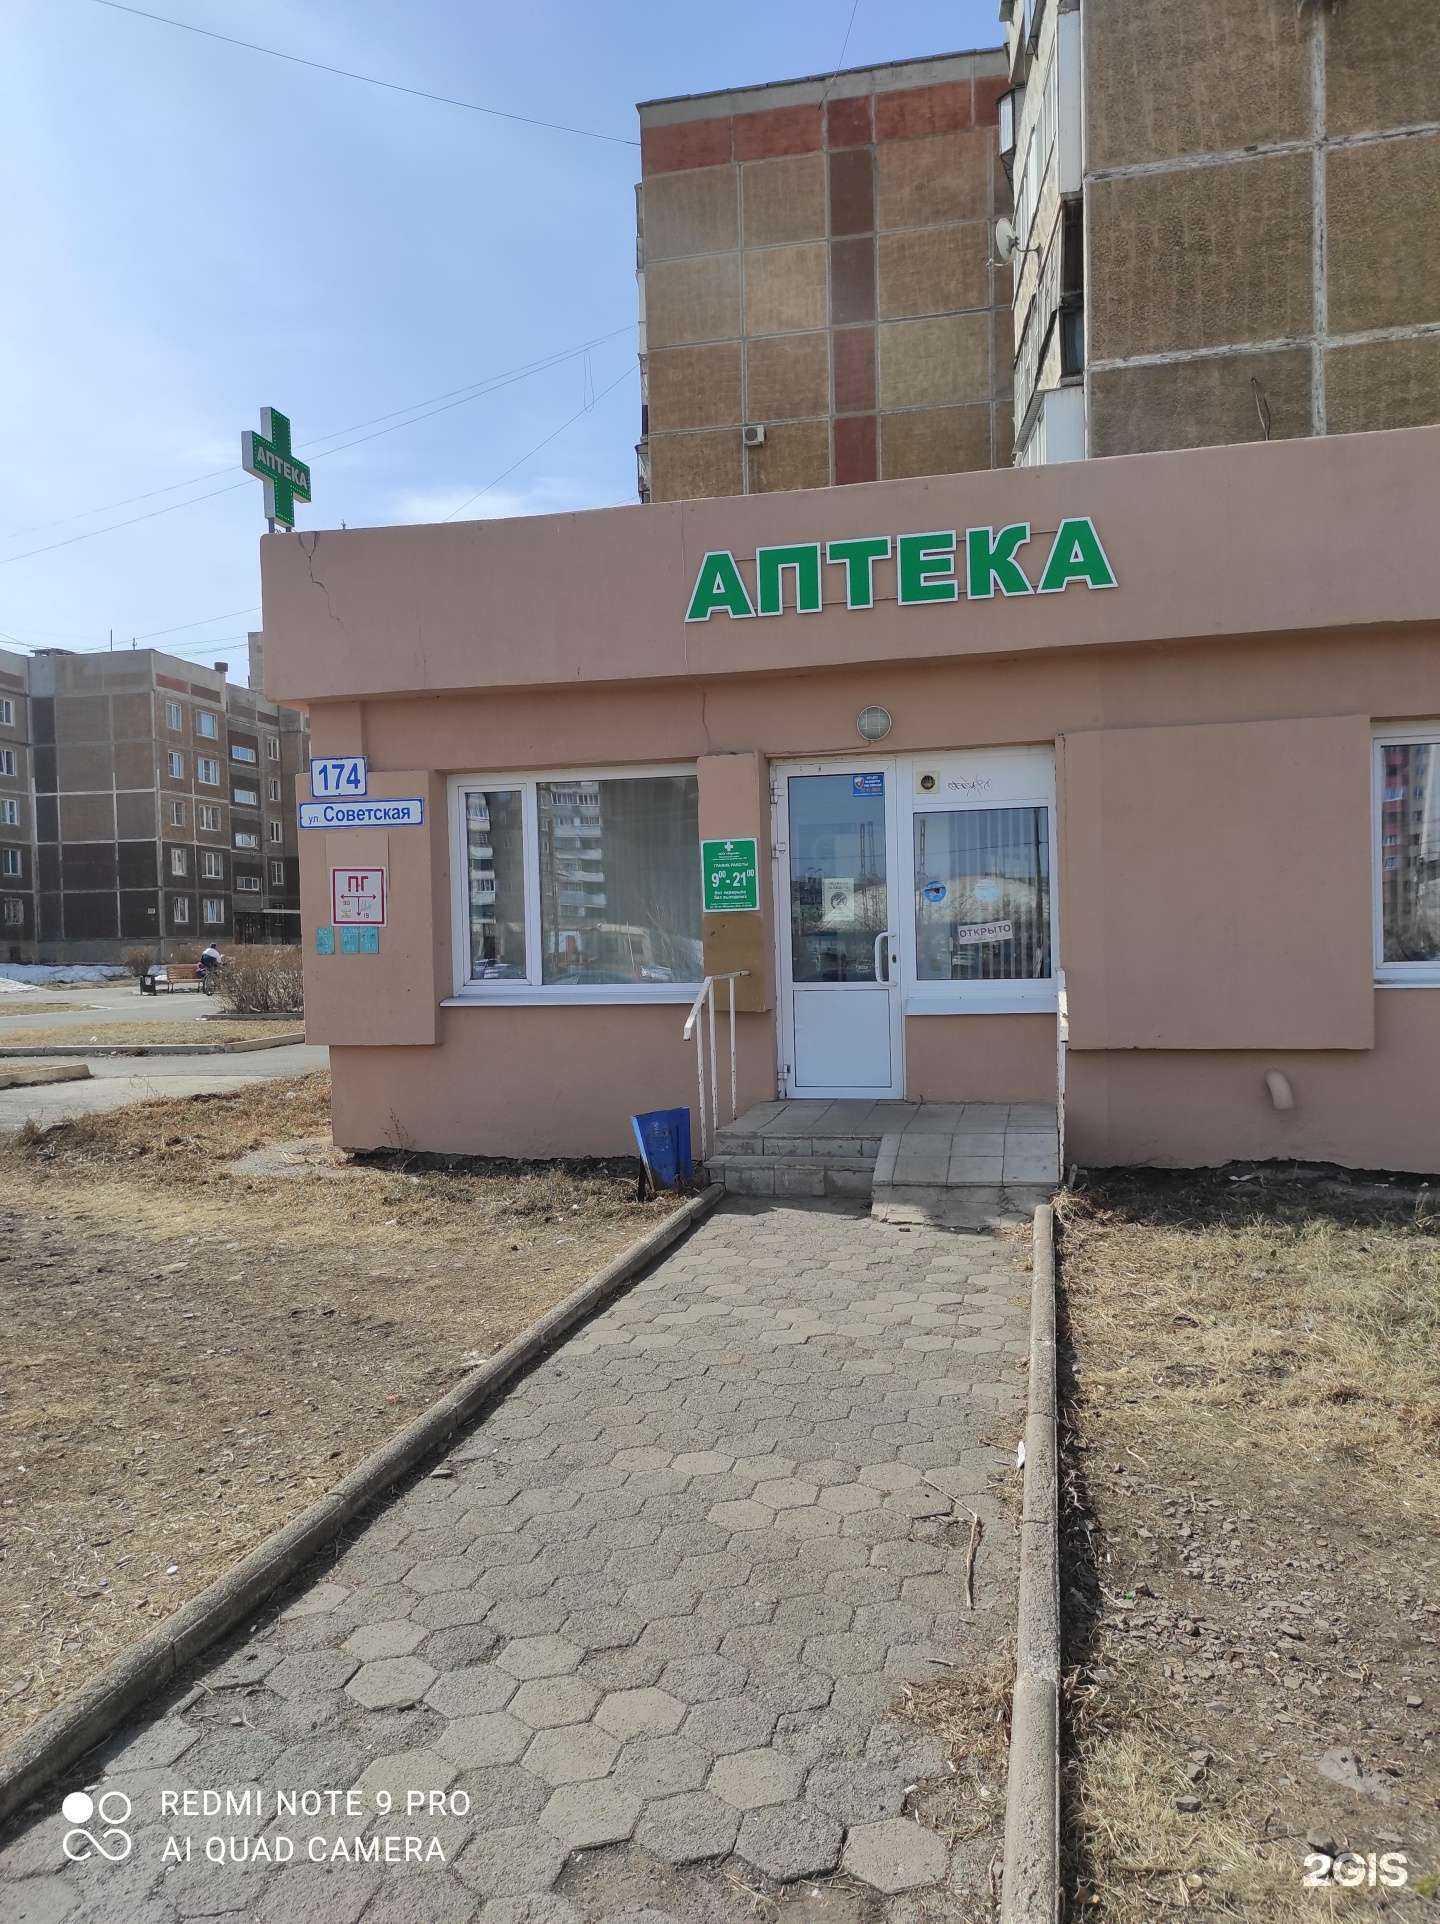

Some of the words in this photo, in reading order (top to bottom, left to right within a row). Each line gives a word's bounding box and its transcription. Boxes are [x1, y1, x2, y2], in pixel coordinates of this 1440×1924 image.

[257, 446, 307, 490] АПТЕКА
[684, 517, 1118, 623] АПТЕКА
[318, 763, 361, 790] 174
[323, 805, 411, 823] Советская
[347, 875, 369, 893] ПГ
[960, 924, 1011, 938] ОТКРЫТО
